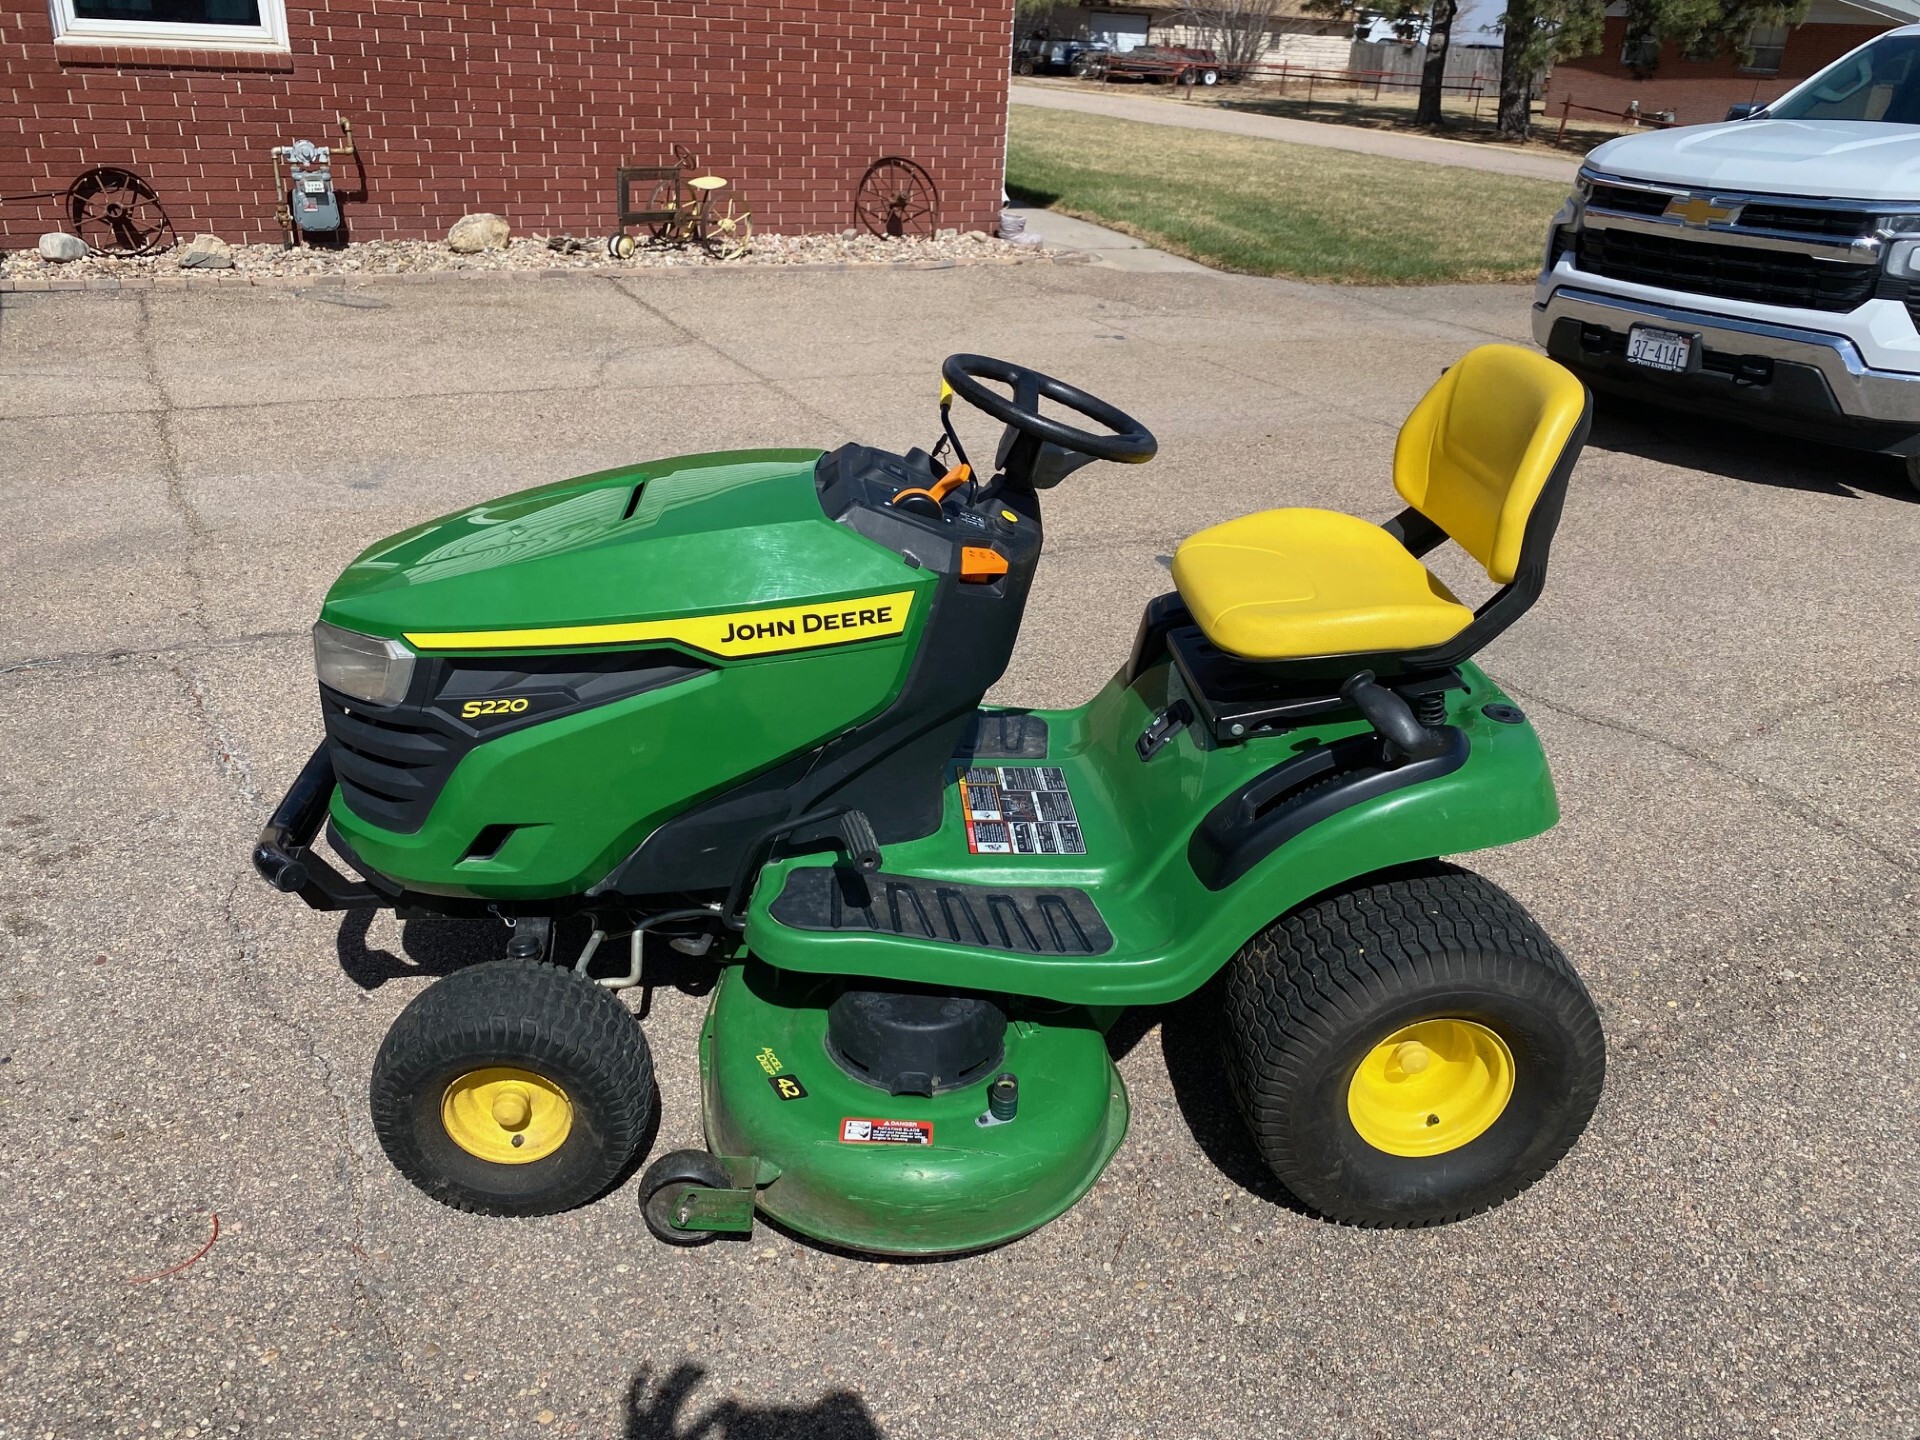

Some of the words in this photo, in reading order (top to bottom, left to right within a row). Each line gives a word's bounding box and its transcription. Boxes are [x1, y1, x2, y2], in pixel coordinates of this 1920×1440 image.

[1633, 339, 1685, 367] 37-414F
[721, 620, 795, 643] JOHN
[802, 606, 892, 633] DEERE
[462, 698, 529, 718] S220
[755, 1054, 776, 1075] DEEP
[761, 1047, 783, 1071] ACCEL
[777, 1078, 800, 1098] 42
